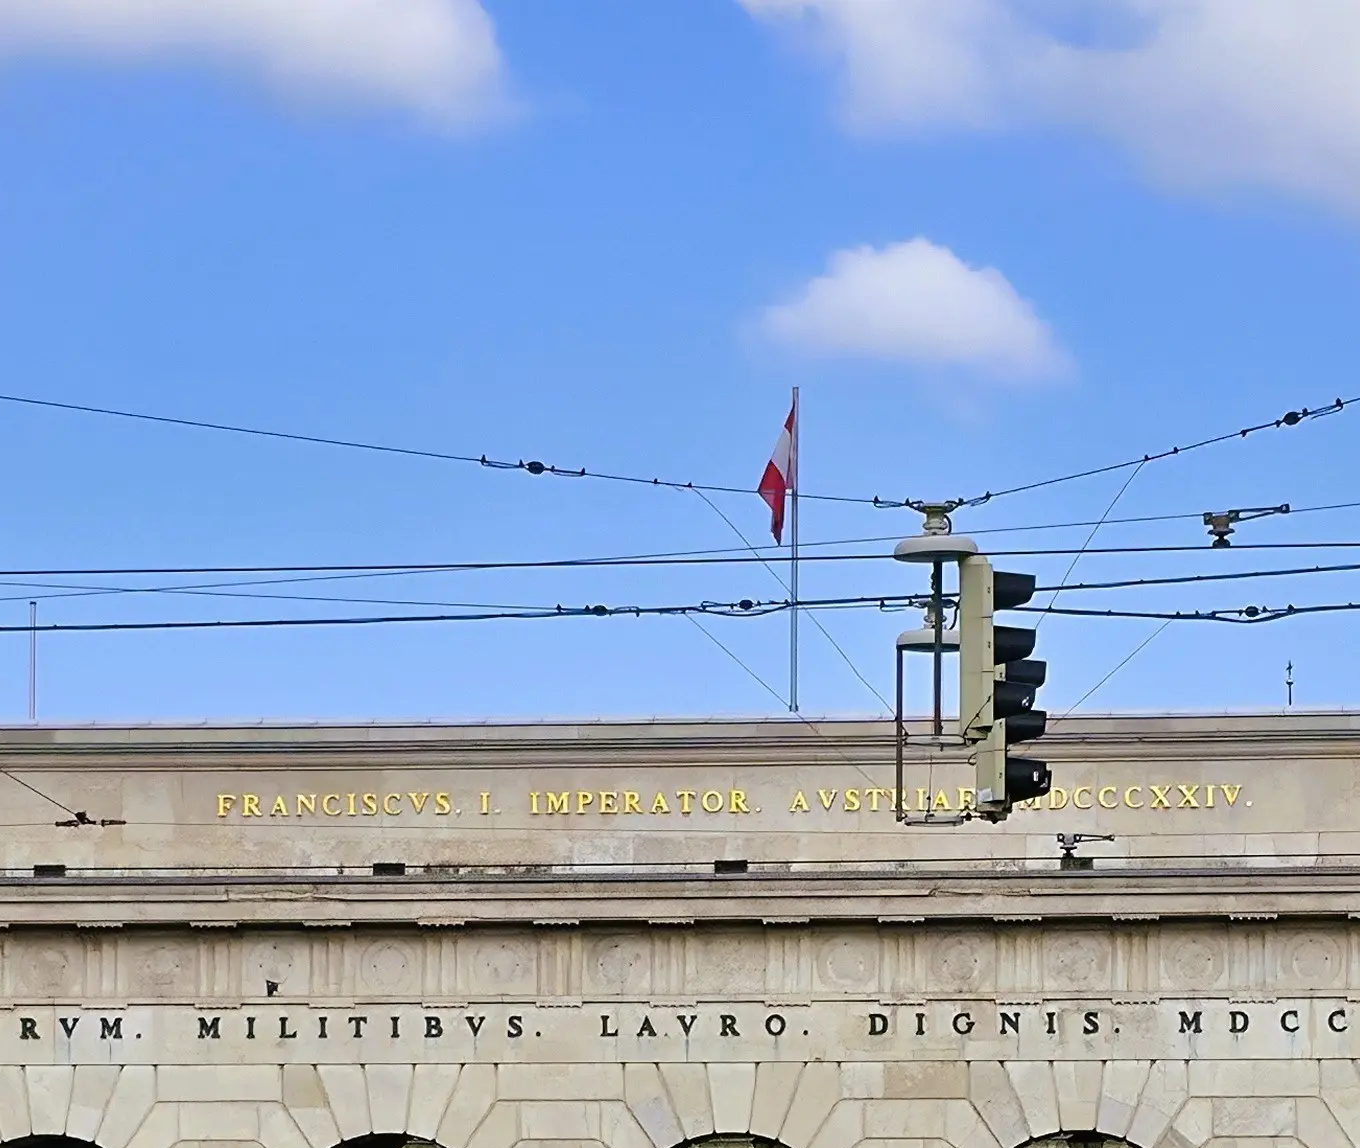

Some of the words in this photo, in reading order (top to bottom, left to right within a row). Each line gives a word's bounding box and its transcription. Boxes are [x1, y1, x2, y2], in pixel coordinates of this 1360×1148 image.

[217, 791, 461, 817] FRANCISCVS.
[529, 789, 762, 815] IMPERATOR.
[197, 1015, 541, 1038] MILITIBVS.
[600, 1013, 809, 1037] LAVRO.
[868, 1011, 1120, 1035] DIGNIS.
